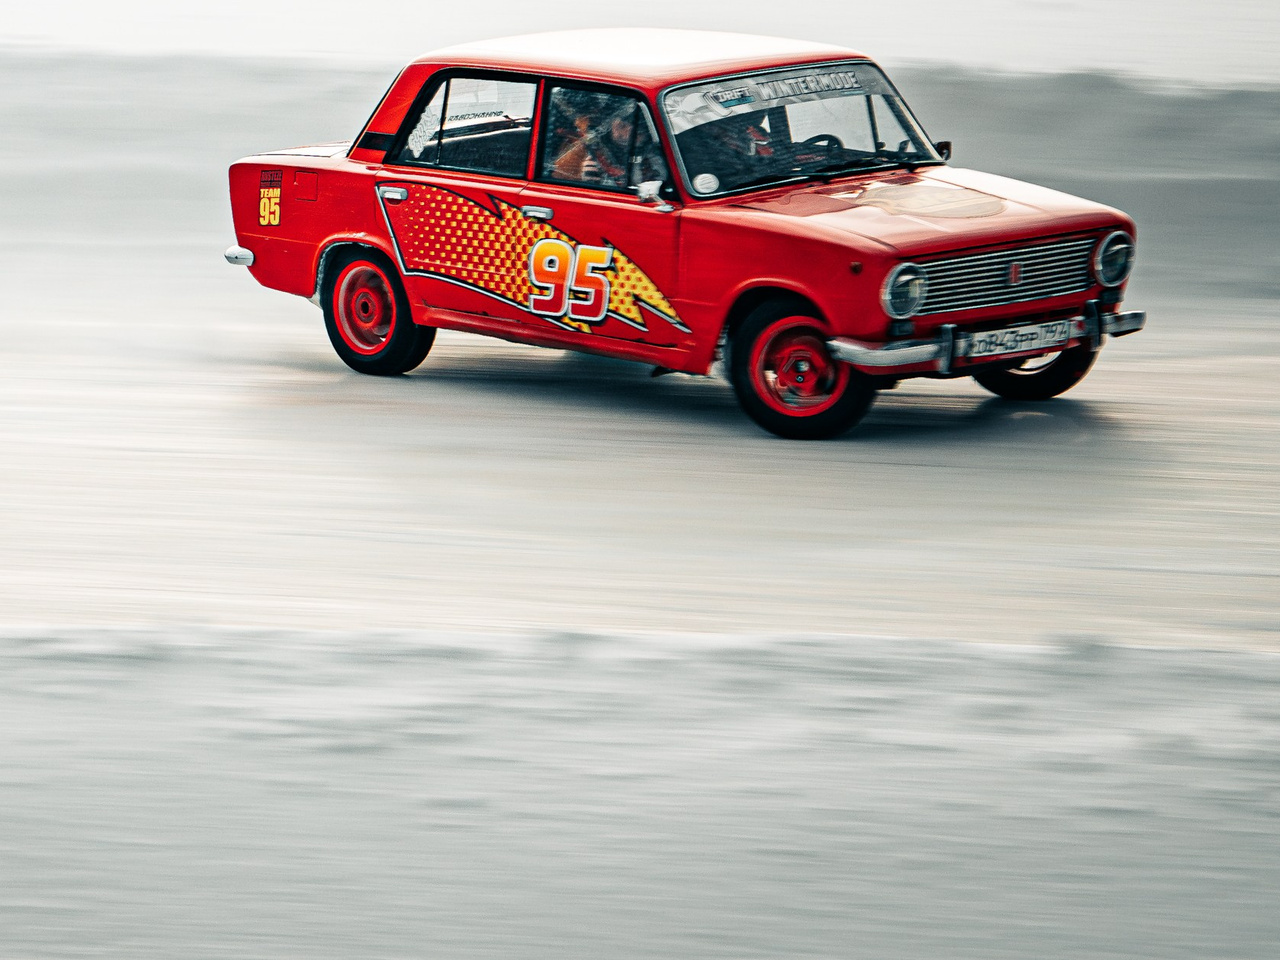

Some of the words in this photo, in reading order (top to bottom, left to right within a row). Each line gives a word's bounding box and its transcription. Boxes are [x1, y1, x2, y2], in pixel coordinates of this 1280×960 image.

[714, 86, 751, 103] DRIFT
[756, 73, 818, 101] WINTER
[819, 71, 862, 92] MODE
[260, 188, 281, 198] TEAM
[259, 197, 280, 226] 95
[528, 238, 614, 323] 95
